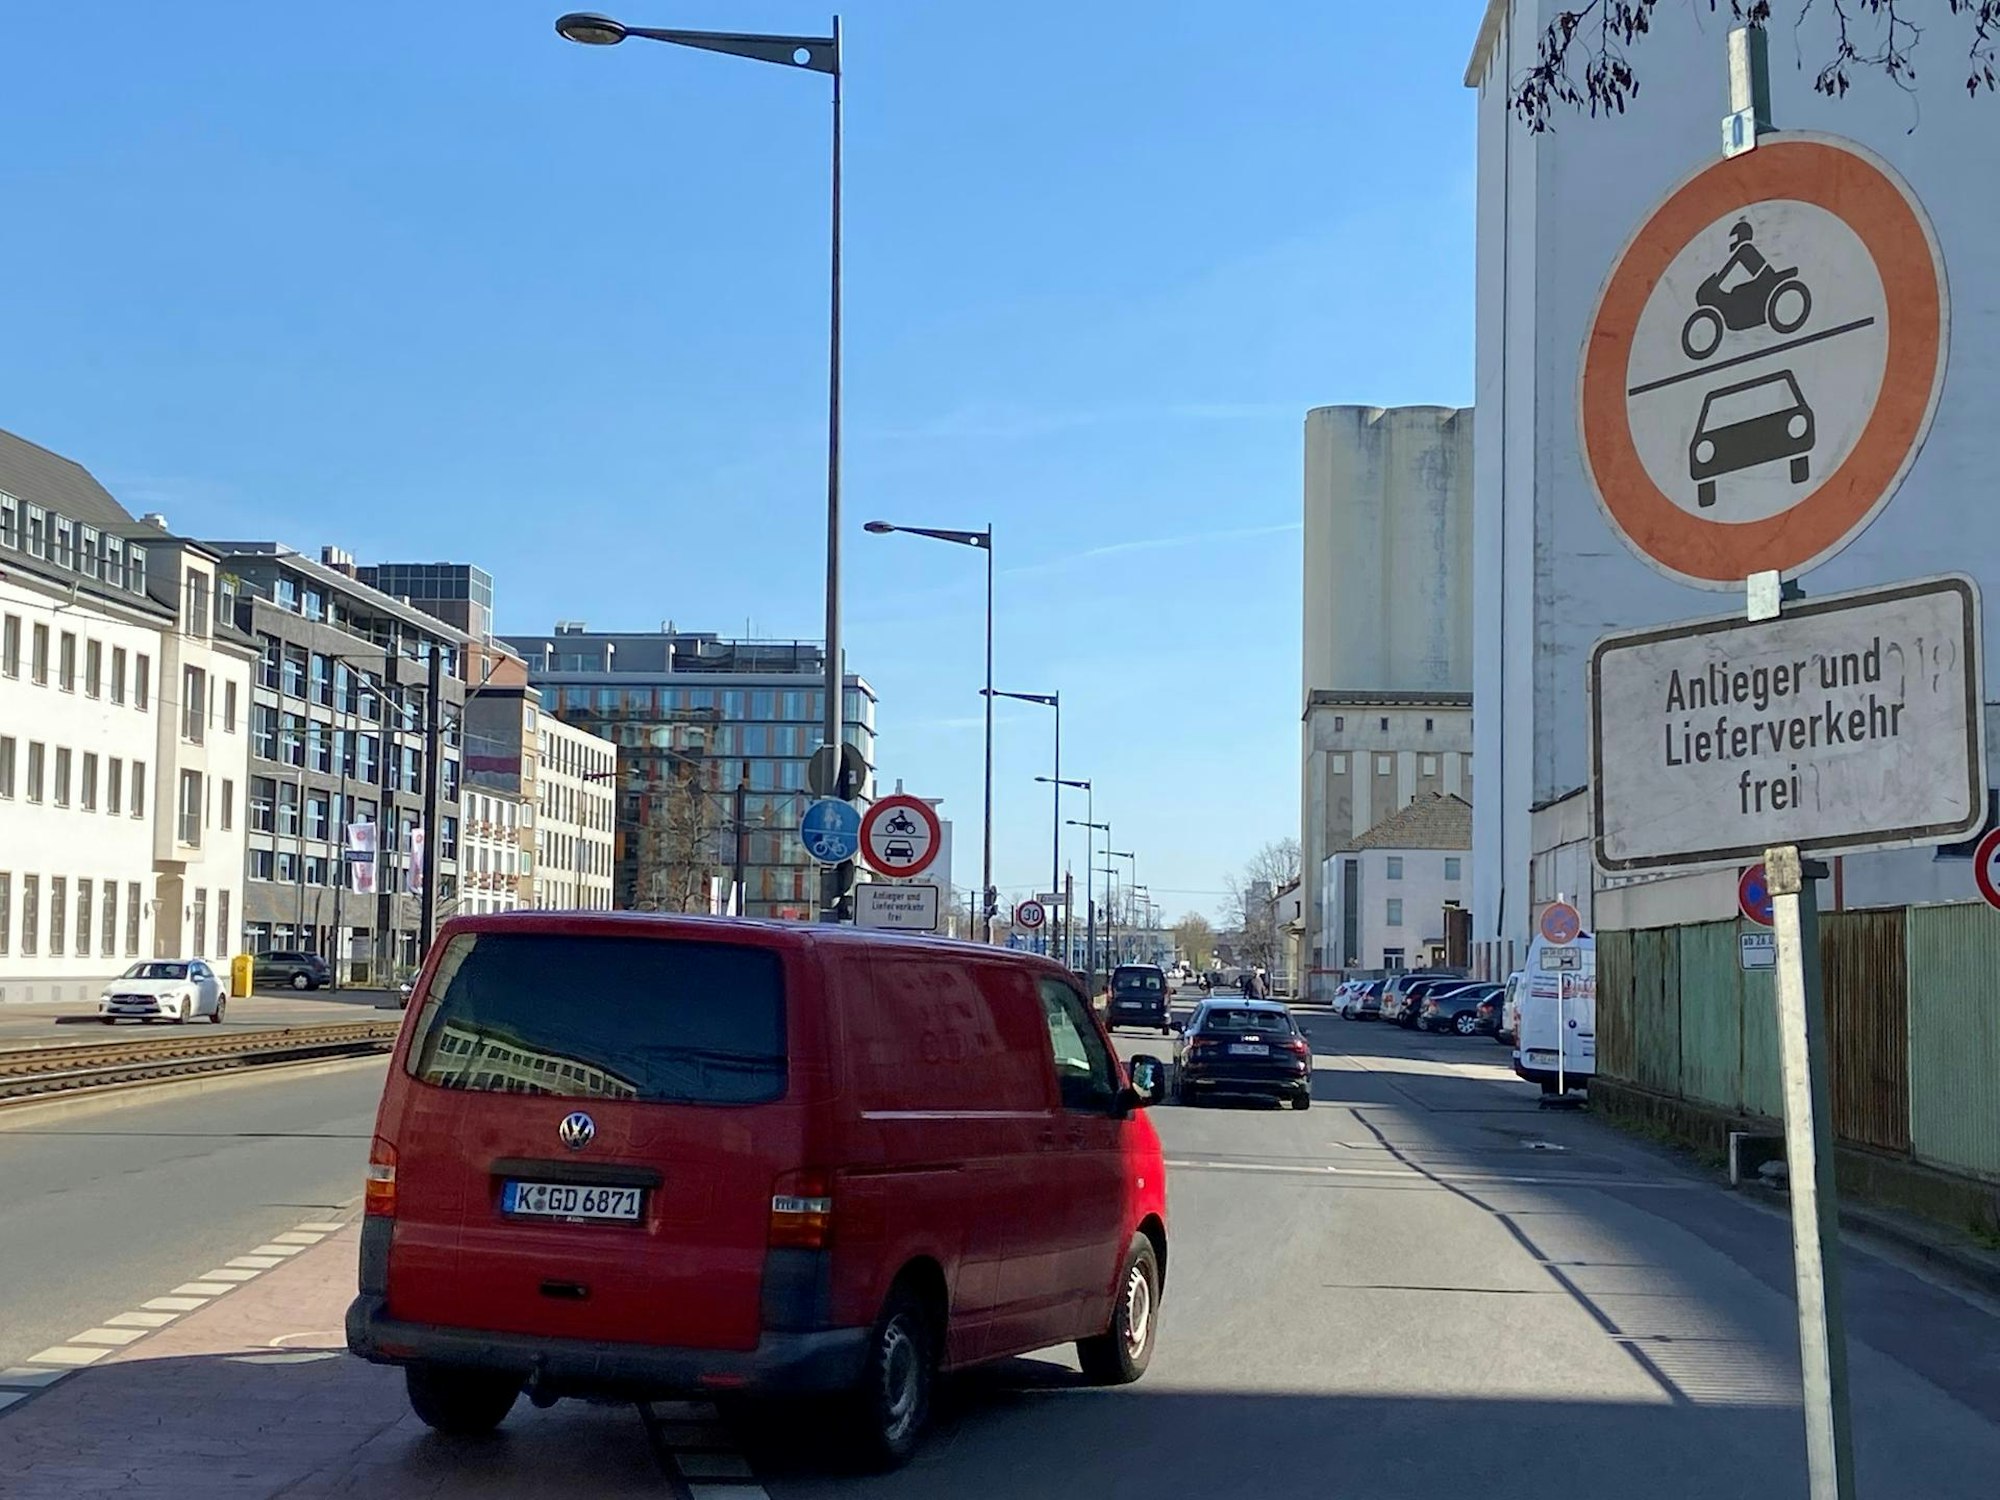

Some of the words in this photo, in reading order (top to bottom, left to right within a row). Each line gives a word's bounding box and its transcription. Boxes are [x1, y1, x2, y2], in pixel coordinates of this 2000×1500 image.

[1665, 660, 1806, 713] Anlieger
[1820, 637, 1881, 689] und
[1665, 694, 1905, 767] Lieferverkehr
[1739, 763, 1799, 815] frei
[872, 901, 925, 911] Lieferverkehr
[873, 891, 905, 902] Anlieger
[907, 893, 921, 901] und
[887, 912, 902, 921] frei
[1023, 908, 1040, 921] 30
[517, 1185, 535, 1210] K
[548, 1188, 578, 1212] GD
[582, 1189, 636, 1215] 6871
